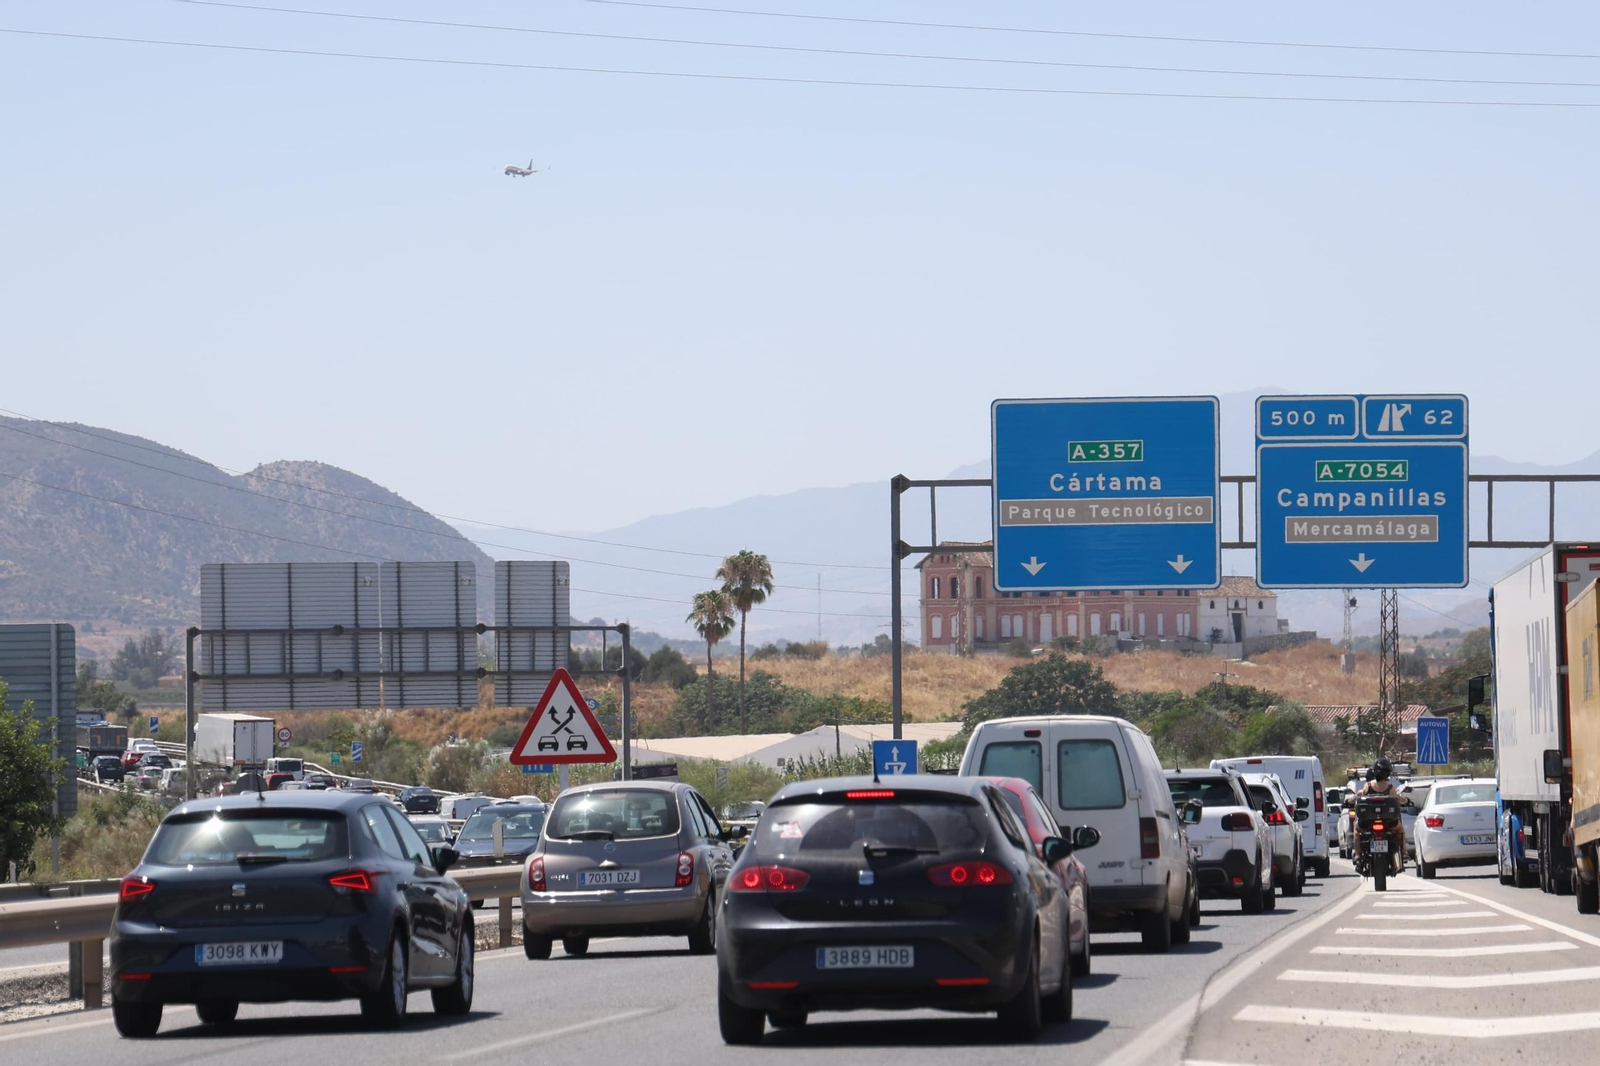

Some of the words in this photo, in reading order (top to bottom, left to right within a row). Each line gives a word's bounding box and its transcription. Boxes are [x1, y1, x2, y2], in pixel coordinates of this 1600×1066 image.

[1271, 410, 1316, 426] 500
[1328, 413, 1345, 425] m
[1424, 410, 1454, 425] 62
[1072, 444, 1140, 459] A-357
[1319, 463, 1405, 479] A-7054
[1049, 472, 1162, 492] Cártama
[1277, 487, 1447, 512] Campanillas
[1008, 504, 1077, 522] Parque
[1089, 502, 1204, 521] Tecnológico
[1293, 520, 1431, 539] Mercamálaga
[1420, 720, 1447, 728] AUTOVÍA
[588, 871, 613, 884] 7031
[617, 870, 637, 883] DZJ
[215, 903, 265, 911] IBIZA
[206, 944, 245, 960] 3098
[250, 943, 279, 958] KWY
[829, 949, 871, 966] 3889
[877, 949, 910, 965] HDB
